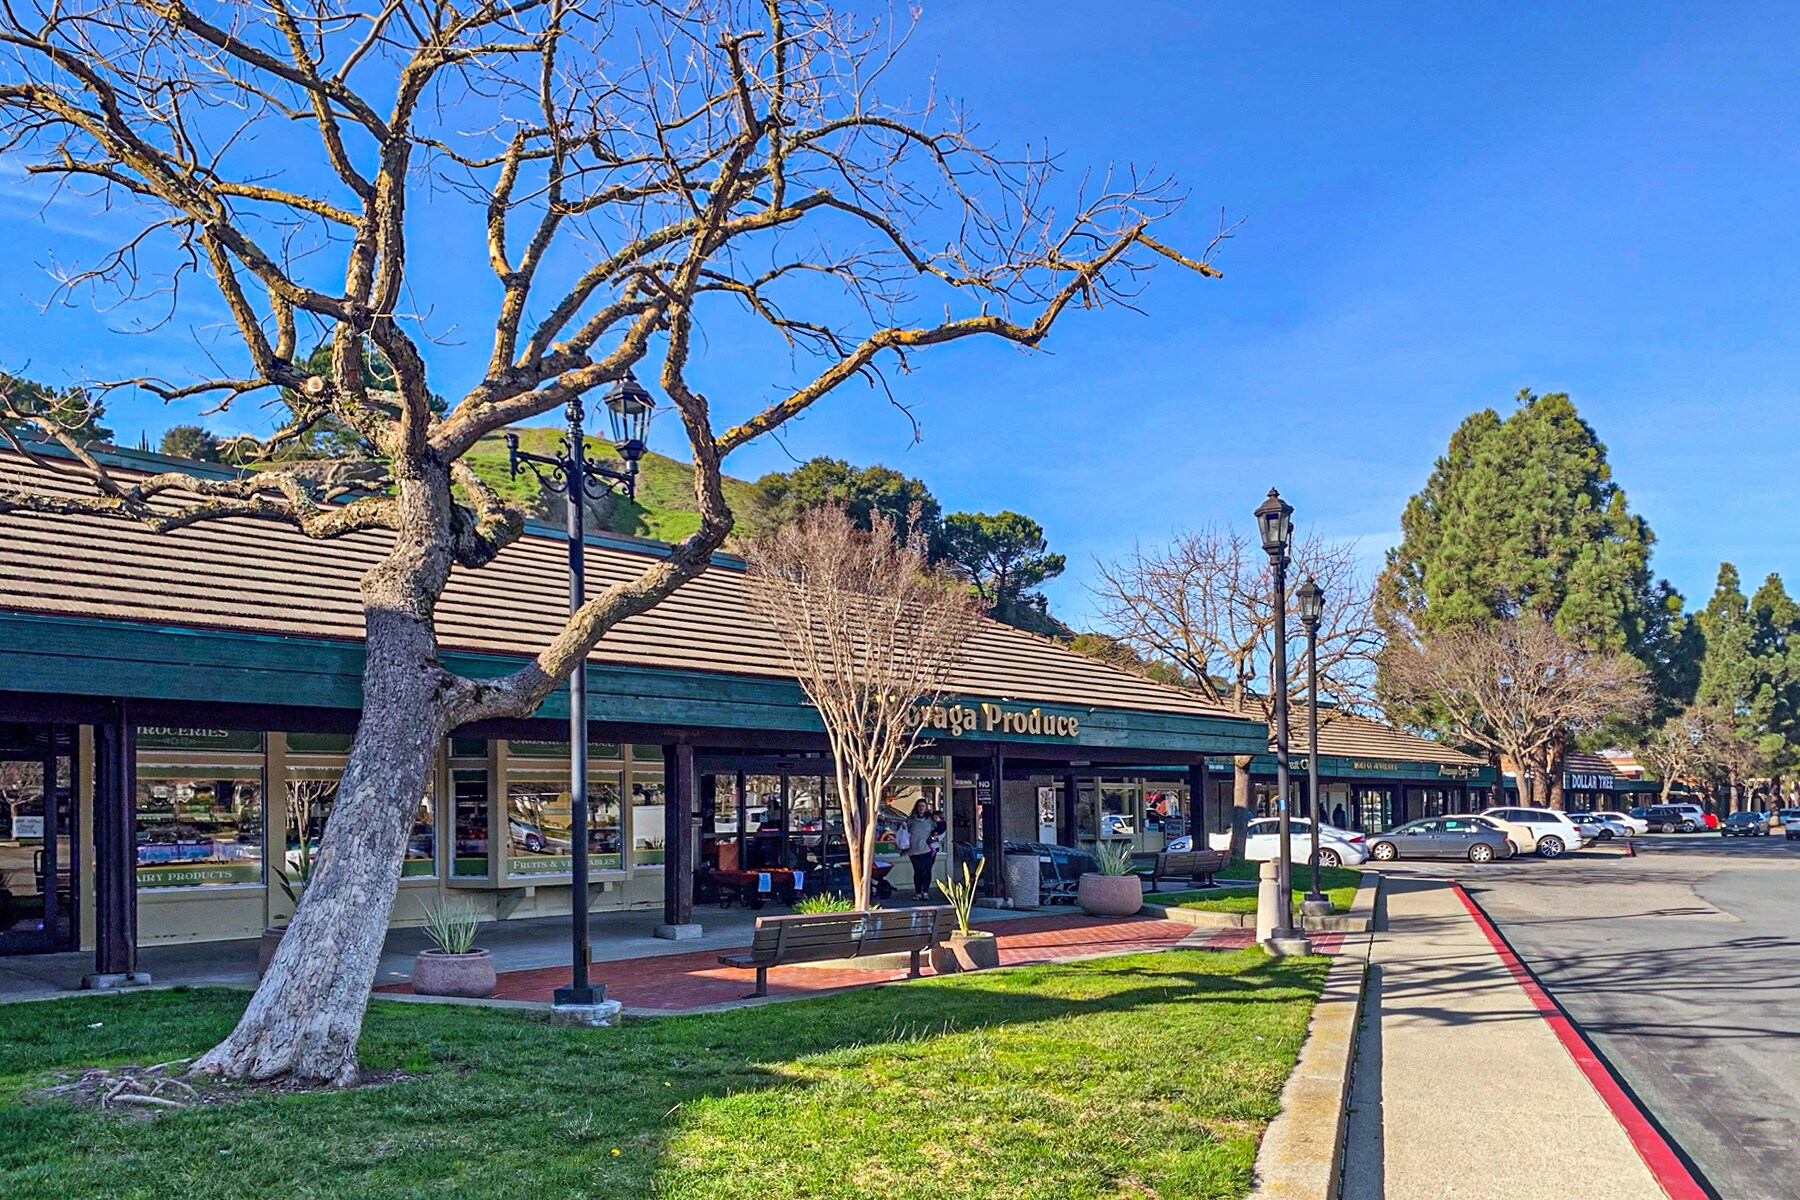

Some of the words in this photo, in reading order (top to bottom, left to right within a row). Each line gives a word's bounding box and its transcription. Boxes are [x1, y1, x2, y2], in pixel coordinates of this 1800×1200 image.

[875, 695, 977, 737] oraga
[981, 703, 1080, 738] Produce
[136, 726, 229, 738] ROCERIES
[978, 780, 990, 789] NO
[1572, 774, 1598, 789] DOLLAR
[1598, 775, 1614, 790] TREE
[513, 860, 547, 870] FRUITS
[549, 860, 558, 868] &
[561, 858, 616, 868] VEABLES
[168, 870, 232, 881] PRODUCTS
